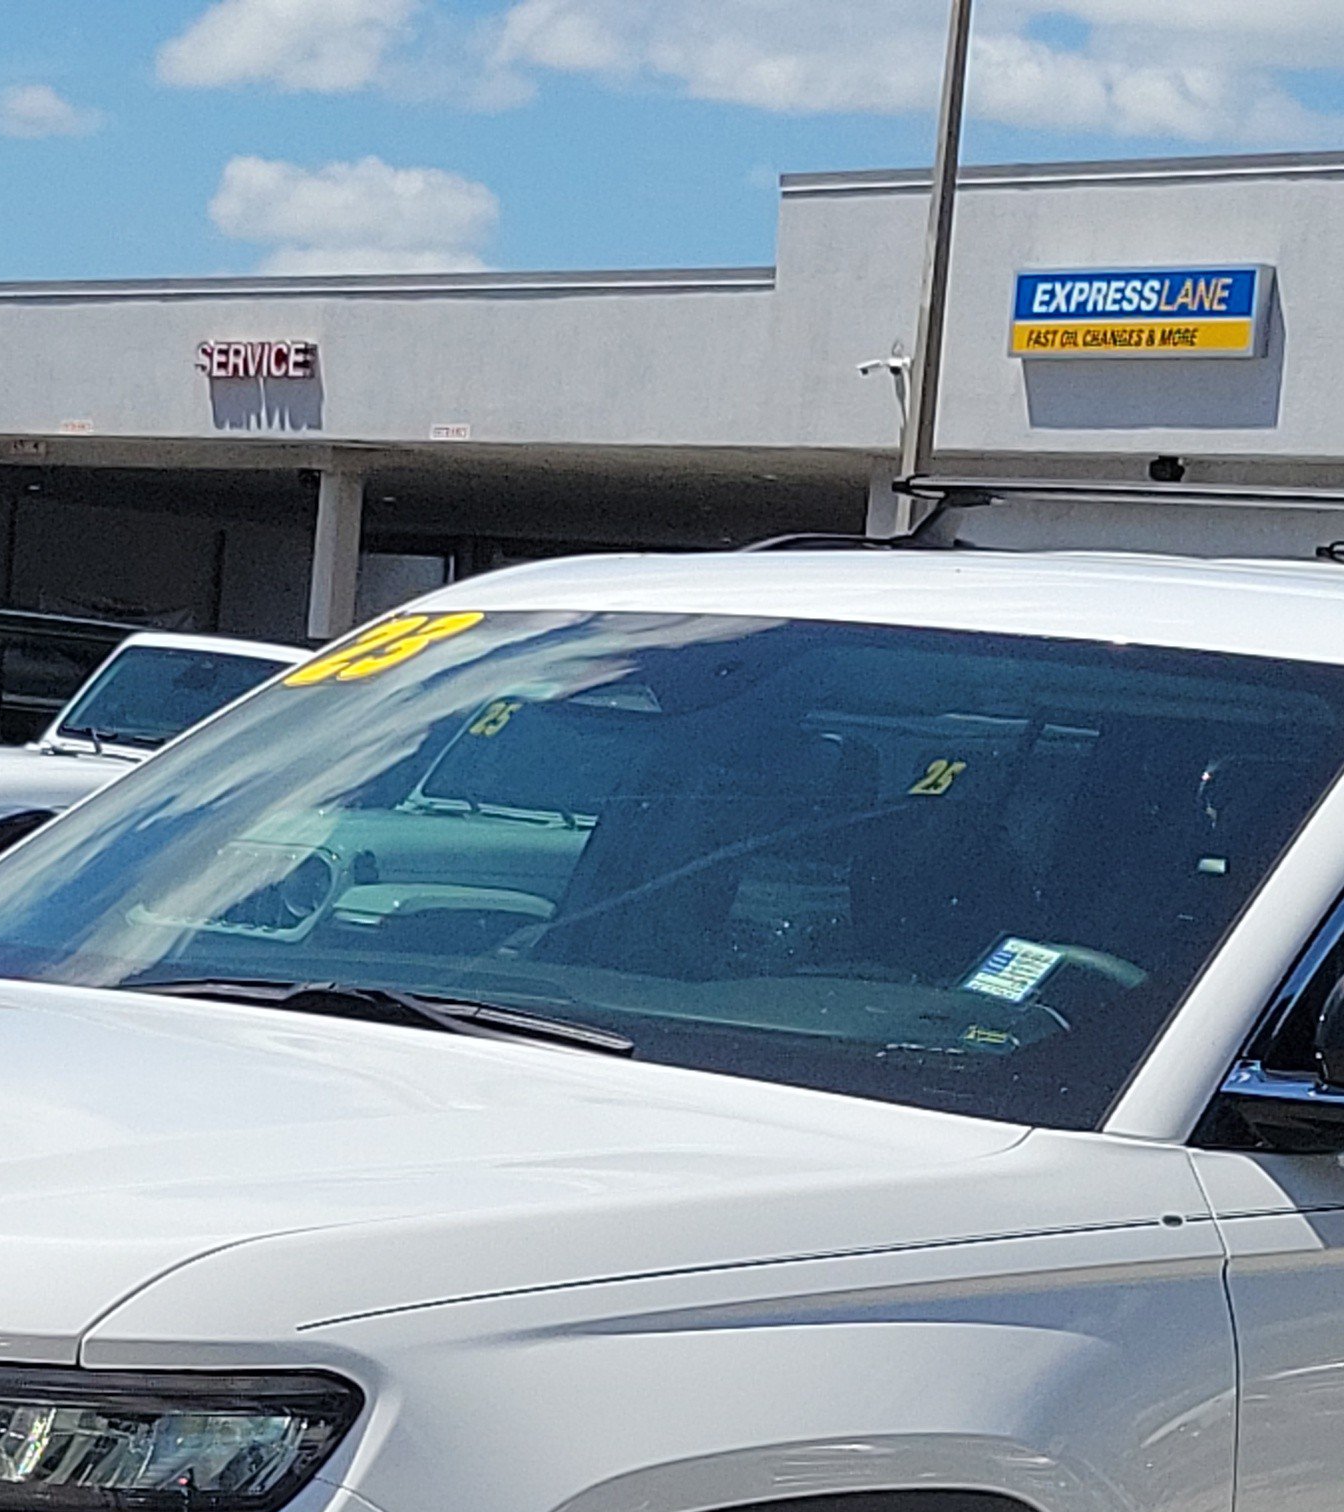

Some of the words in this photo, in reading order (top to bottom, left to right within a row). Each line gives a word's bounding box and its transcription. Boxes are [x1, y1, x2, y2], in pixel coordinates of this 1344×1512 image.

[1027, 329, 1060, 347] FAST
[1060, 329, 1080, 347] OIL
[1081, 329, 1145, 347] CHANGES
[1145, 329, 1156, 346] &
[1157, 327, 1199, 347] MORE
[195, 341, 316, 378] SERVICE
